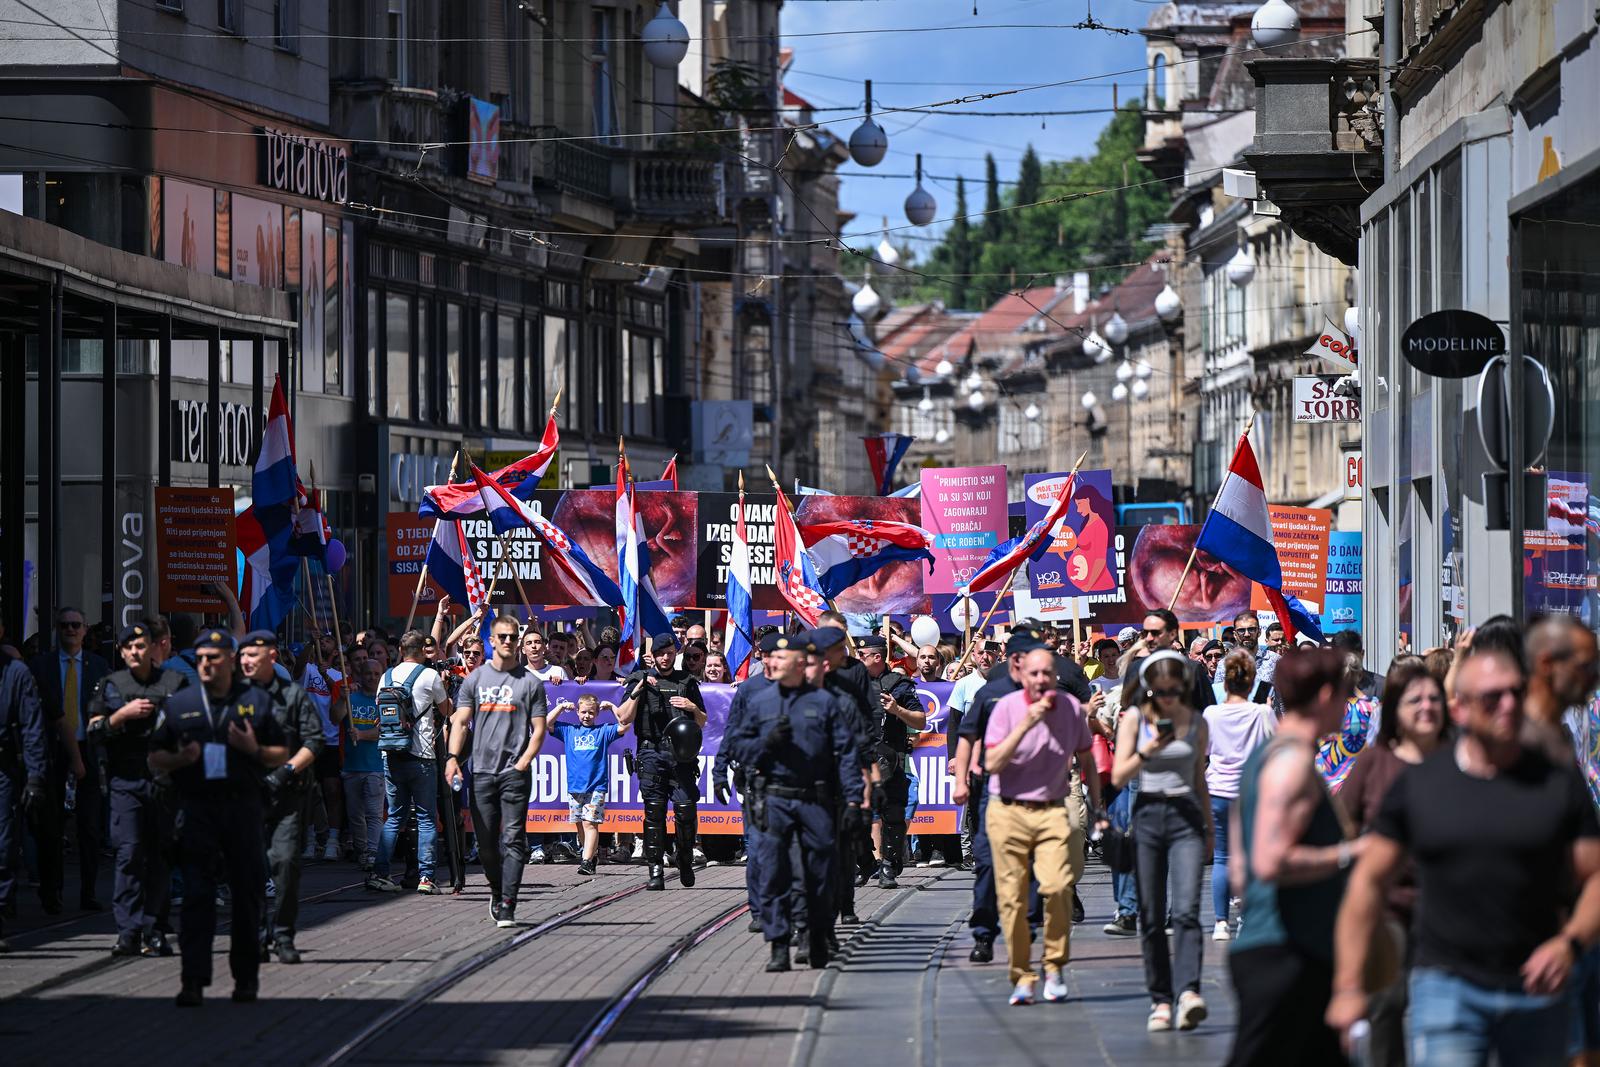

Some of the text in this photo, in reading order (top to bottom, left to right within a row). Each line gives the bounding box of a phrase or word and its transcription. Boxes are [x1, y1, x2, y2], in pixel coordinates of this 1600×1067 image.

[1409, 337, 1498, 351] MODELINE
[1300, 400, 1360, 420] TORB
[981, 475, 995, 485] SAM
[939, 491, 991, 502] DA SU SVI KOJI
[943, 506, 987, 517] ZAGOVARAJU
[951, 521, 982, 532] POBAČAJ
[1288, 522, 1310, 531] ljudski
[1311, 524, 1326, 532] život
[397, 529, 404, 540] 9
[942, 536, 957, 548] VEĆ
[1287, 542, 1319, 551] prijetnjom
[397, 545, 411, 556] OD
[477, 541, 487, 559] S
[396, 562, 419, 573] SISA
[1300, 562, 1316, 570] moja
[1297, 572, 1318, 580] znanja
[1326, 580, 1345, 593] UCA
[617, 814, 643, 822] SISAK
[699, 815, 725, 824] BROD
